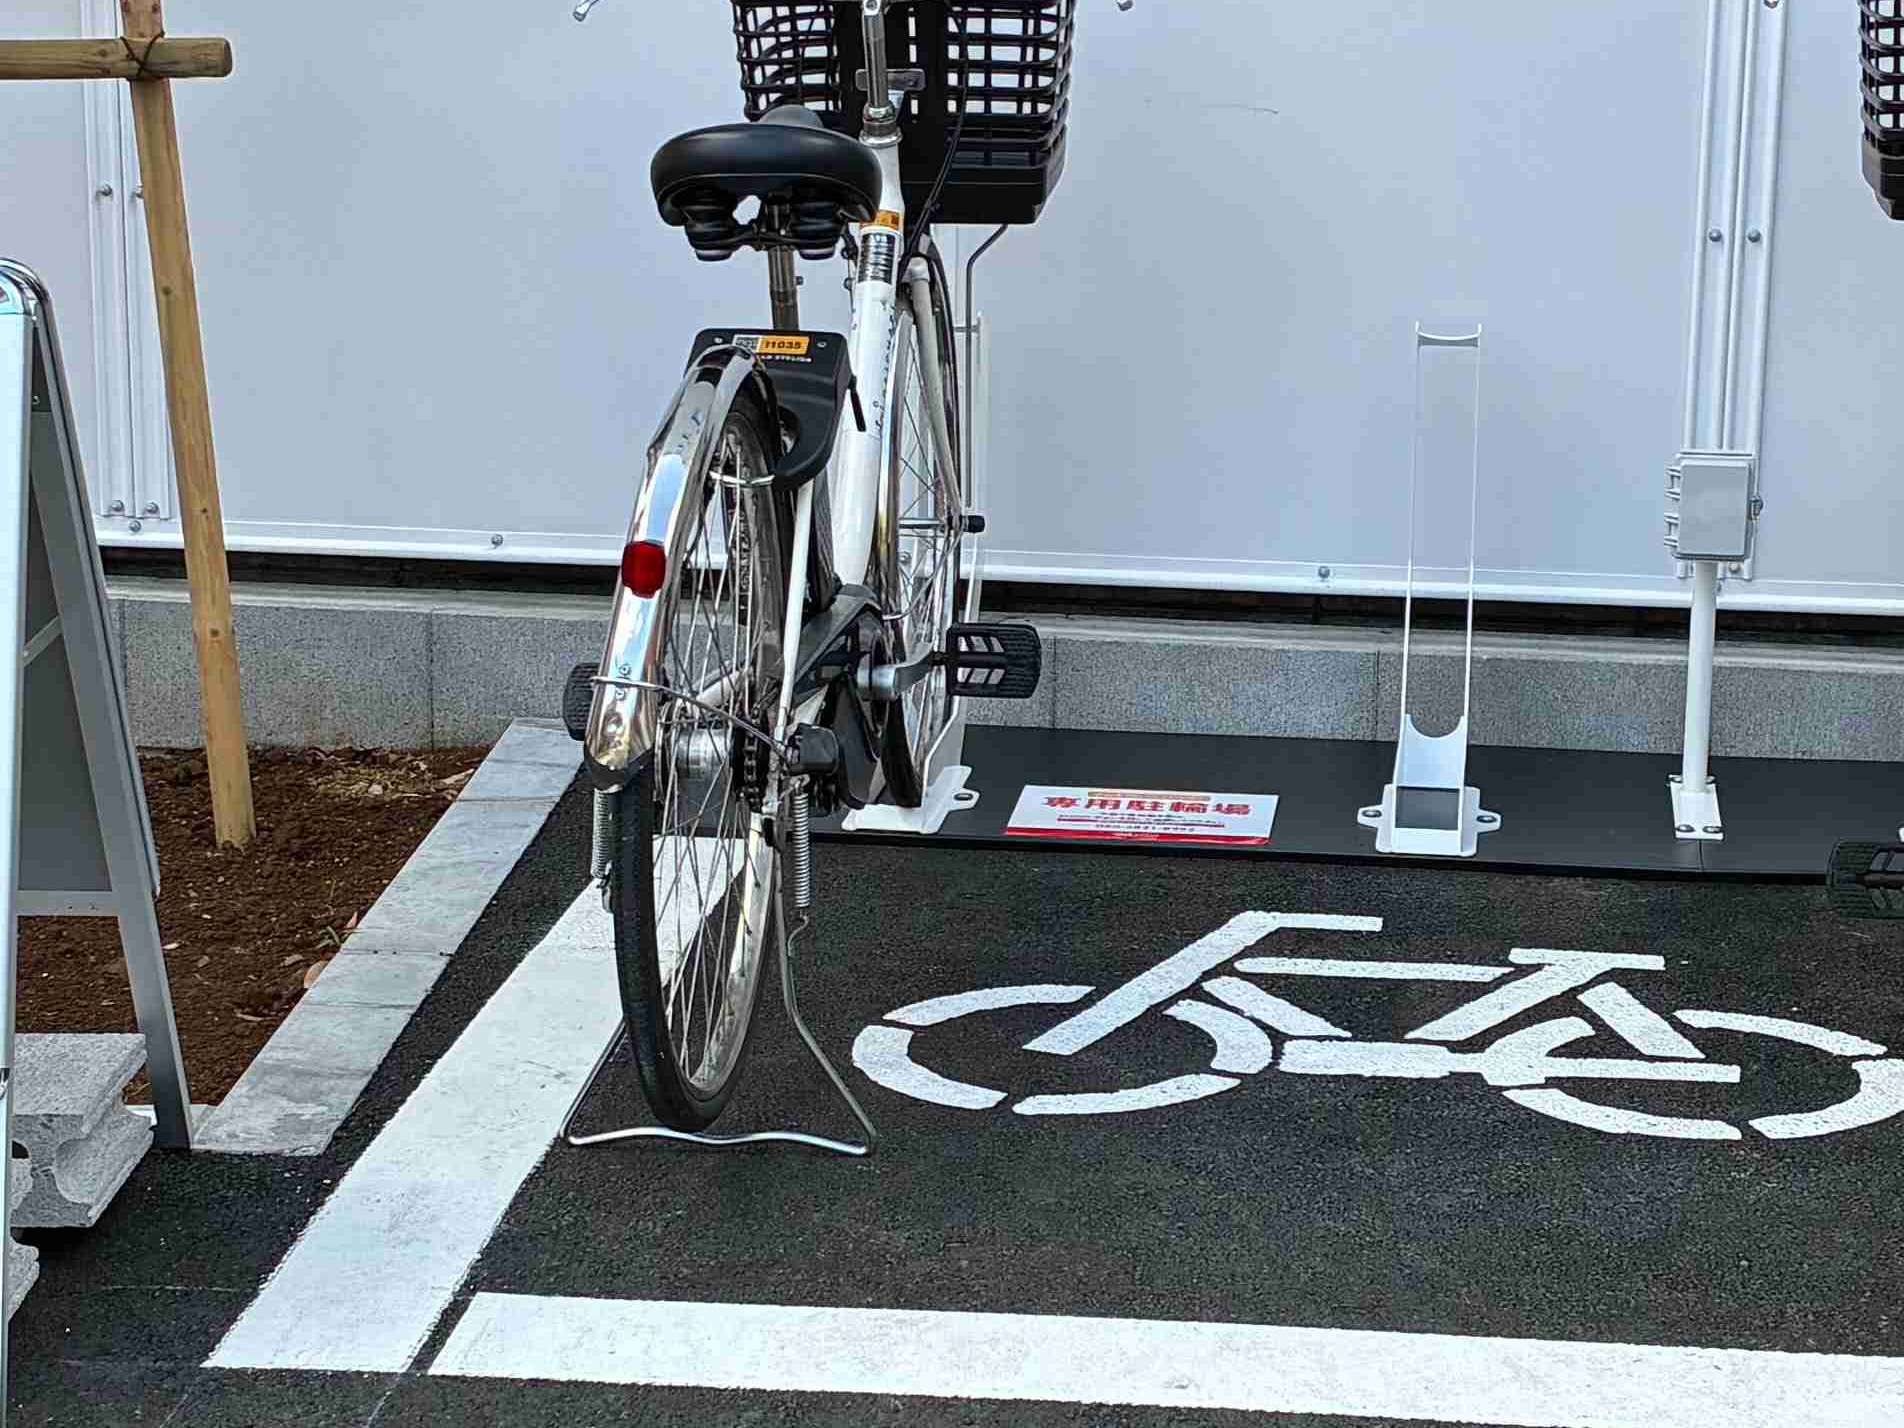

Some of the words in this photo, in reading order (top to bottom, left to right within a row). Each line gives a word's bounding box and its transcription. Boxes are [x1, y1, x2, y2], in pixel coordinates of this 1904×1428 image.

[1043, 796, 1251, 816] 専用駐輪場
